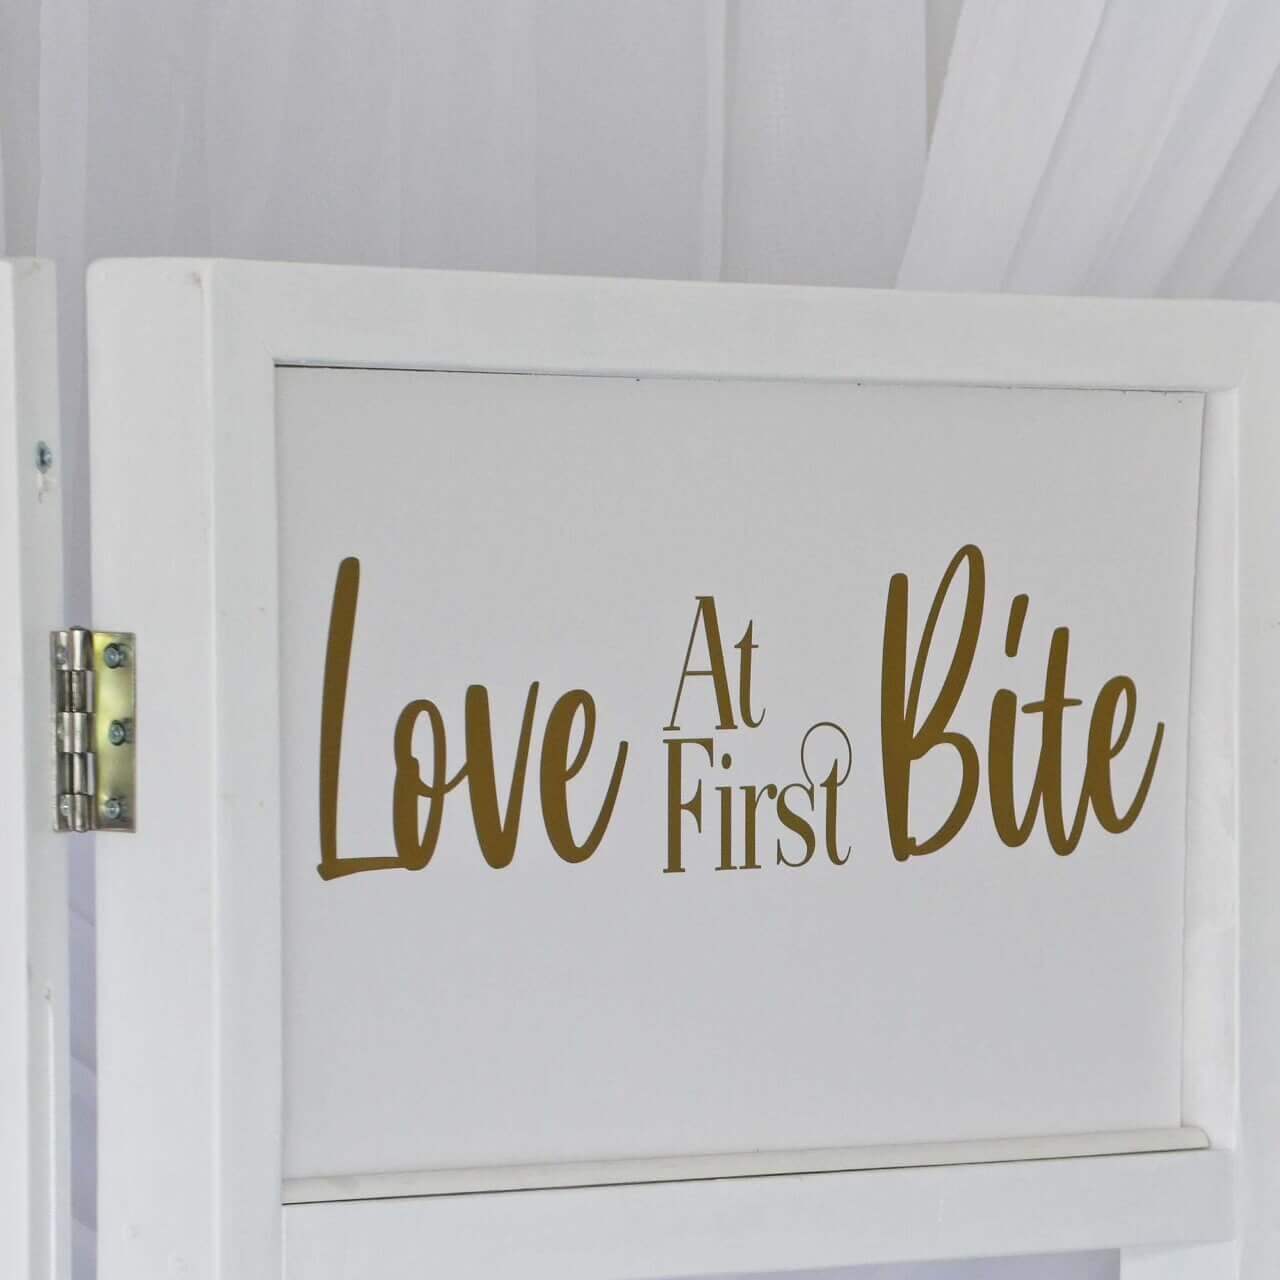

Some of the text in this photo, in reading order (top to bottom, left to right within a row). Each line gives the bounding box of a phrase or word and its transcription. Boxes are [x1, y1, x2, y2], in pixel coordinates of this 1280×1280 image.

[317, 556, 629, 881] Love
[663, 595, 766, 731] At
[881, 544, 1165, 862] Bite
[663, 722, 852, 873] First
